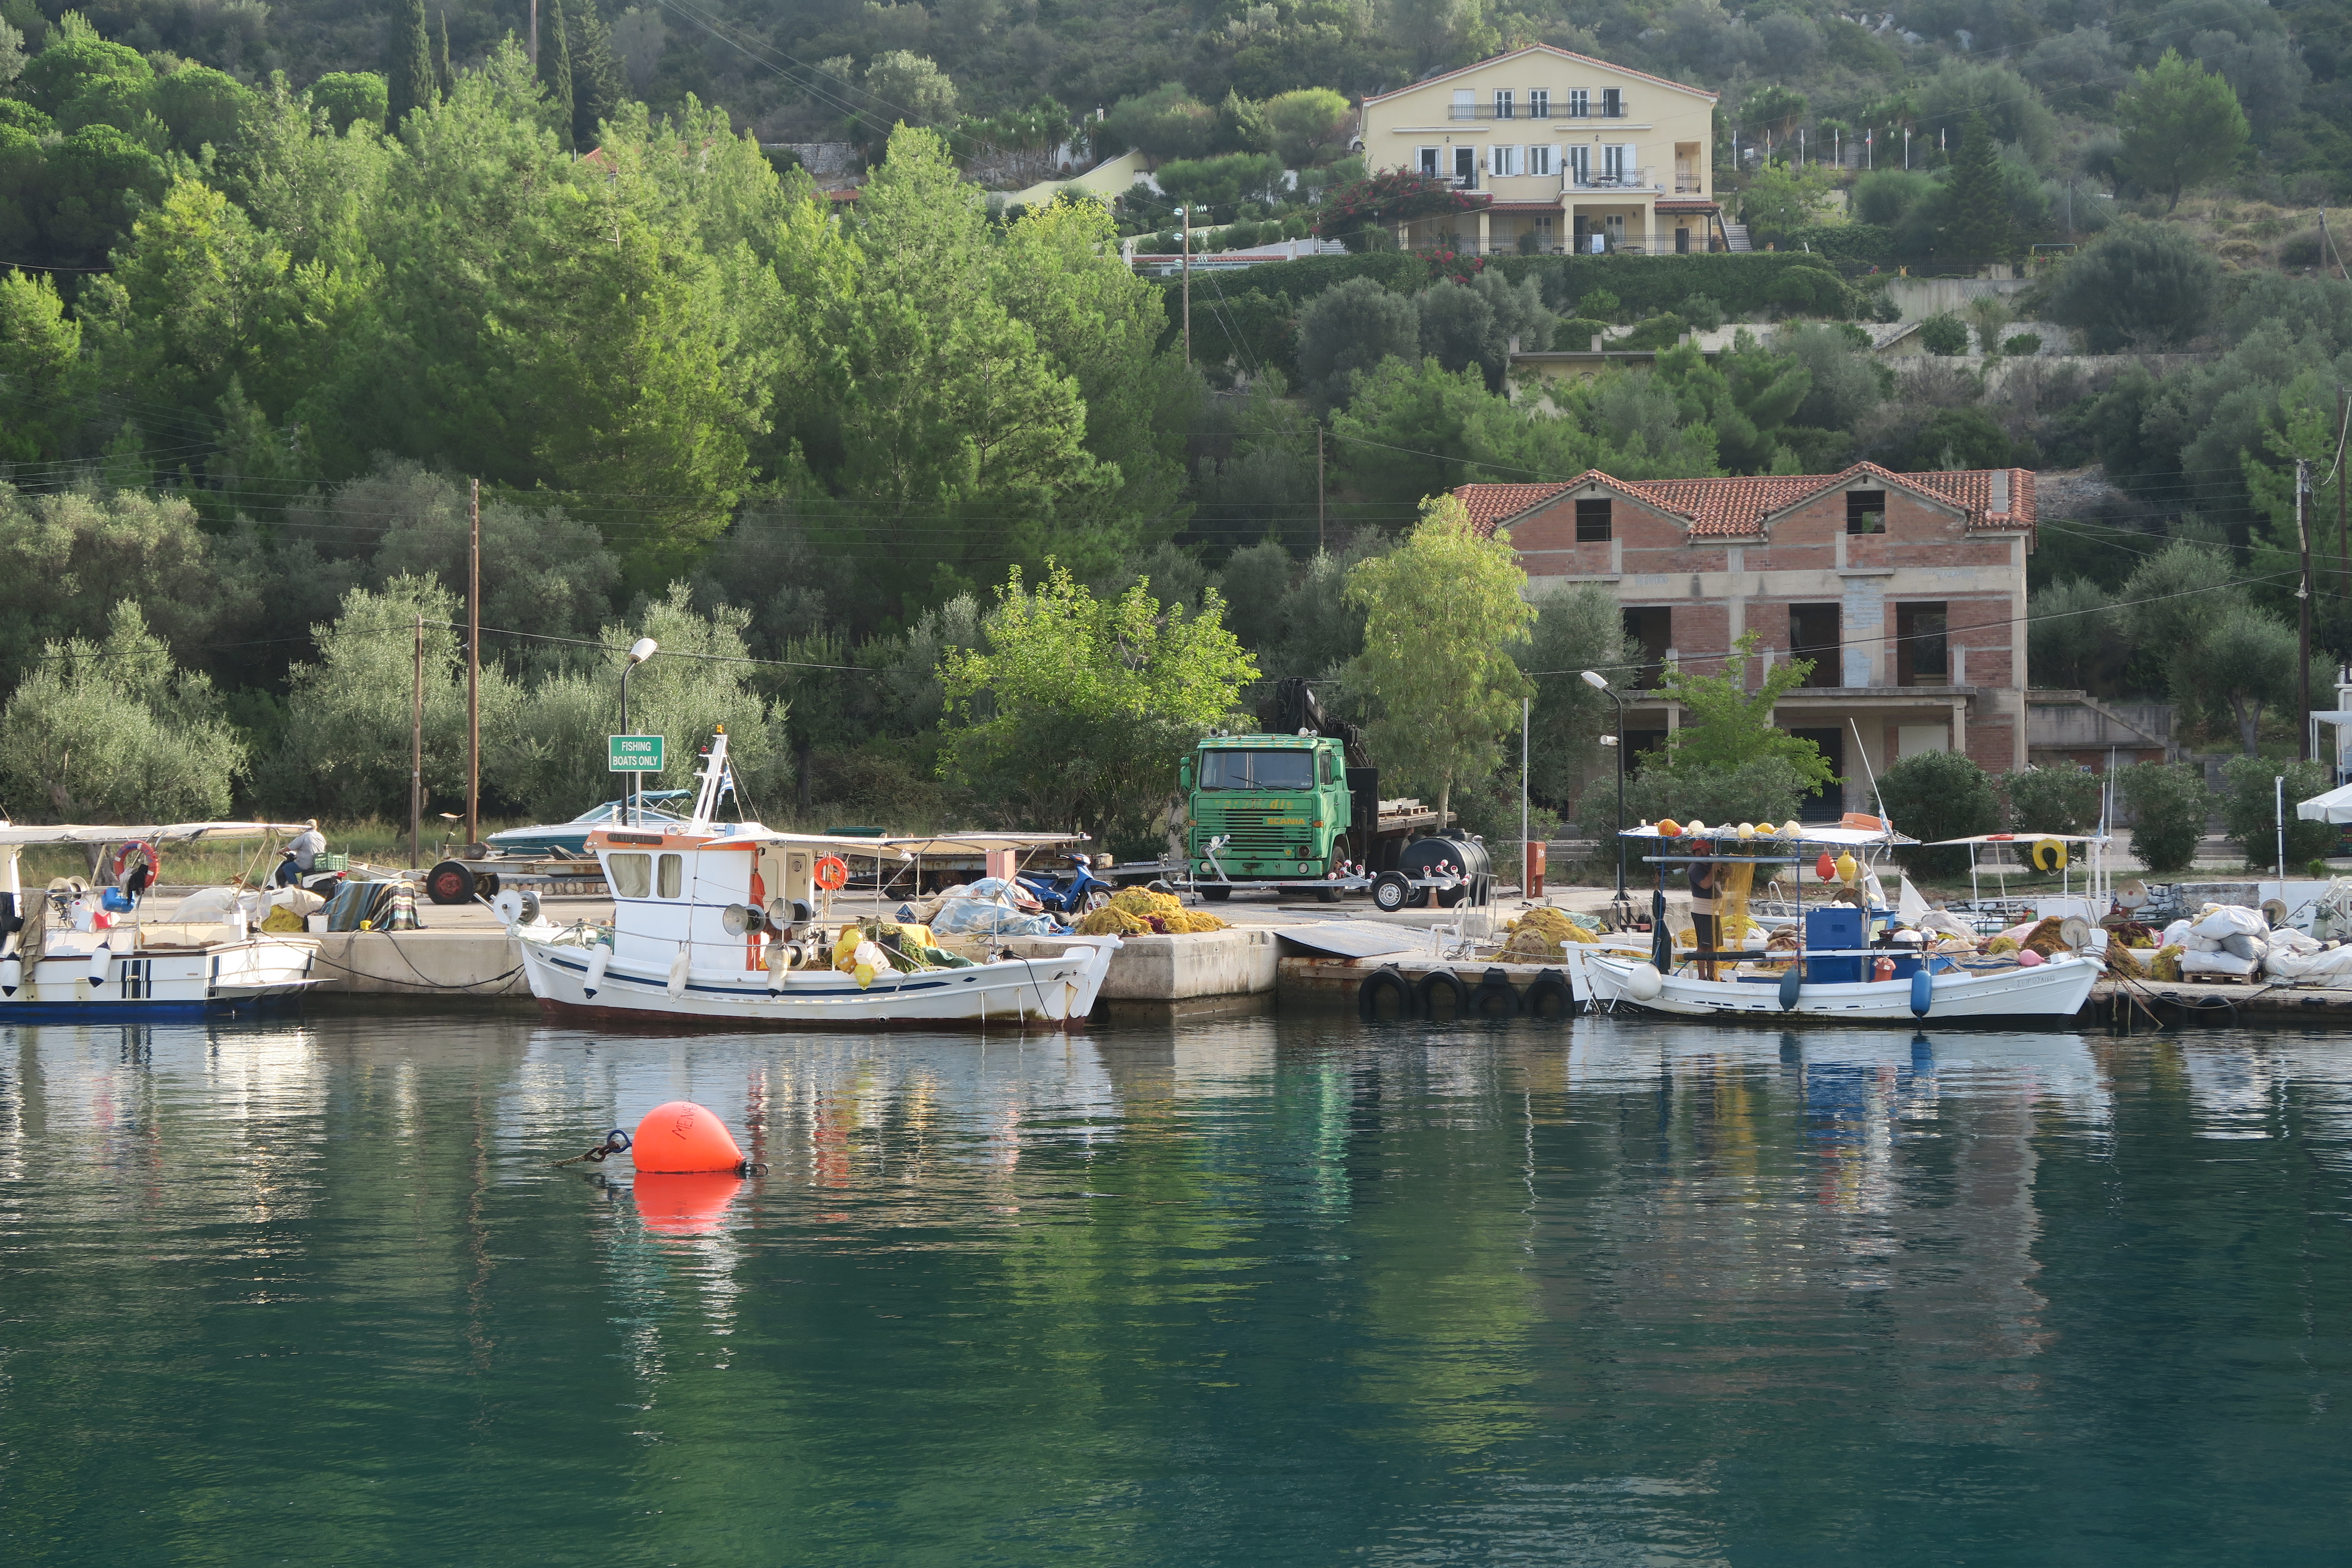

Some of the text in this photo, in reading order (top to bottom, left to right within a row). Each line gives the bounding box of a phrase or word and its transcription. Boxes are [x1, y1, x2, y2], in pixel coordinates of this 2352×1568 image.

[622, 741, 652, 752] FISHING
[612, 756, 658, 766] BOATS ONLY
